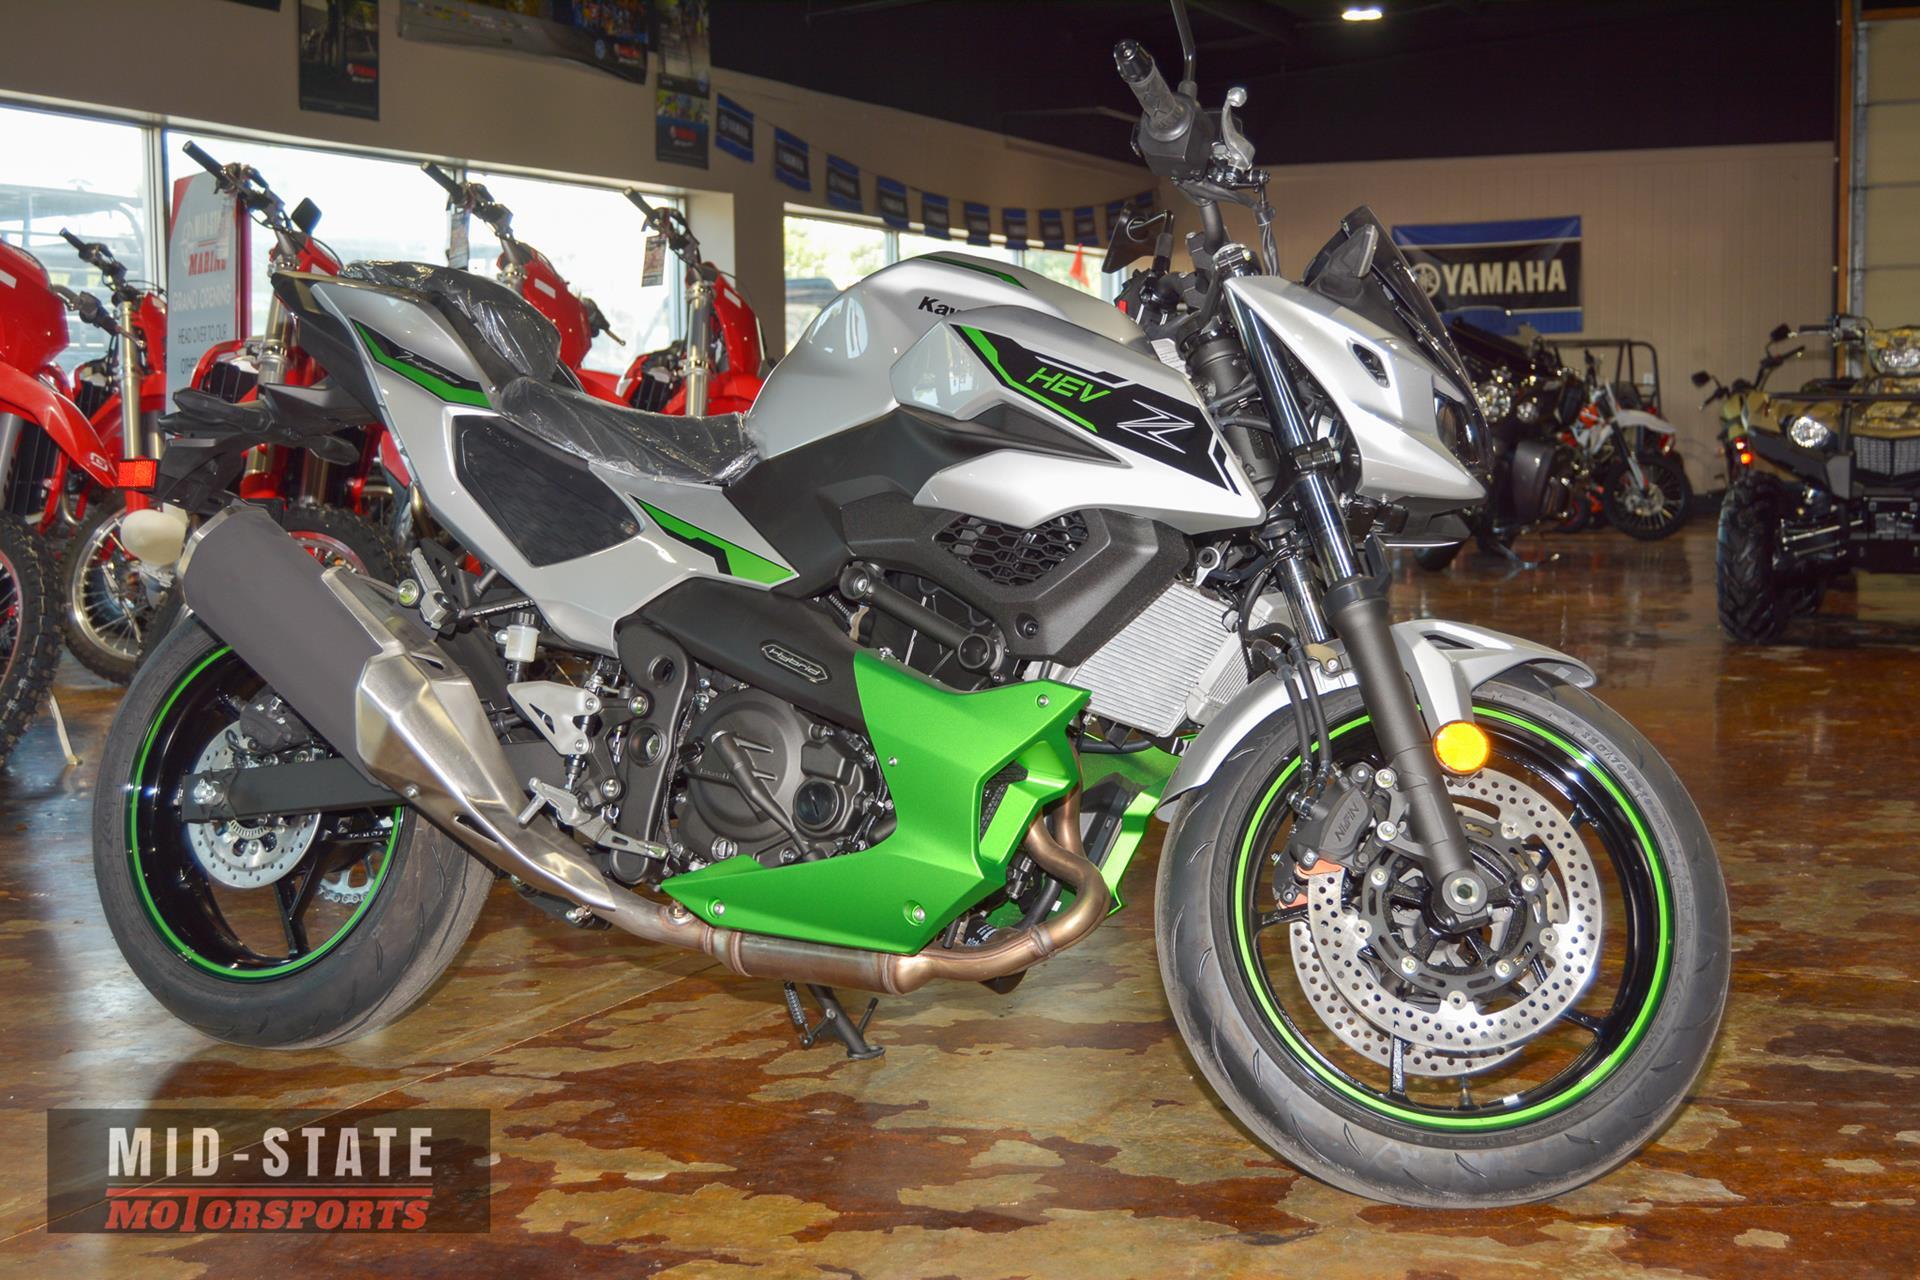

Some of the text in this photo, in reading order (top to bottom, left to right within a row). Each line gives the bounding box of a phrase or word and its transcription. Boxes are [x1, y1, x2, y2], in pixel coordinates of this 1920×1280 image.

[1441, 261, 1567, 296] YAMAHA
[1026, 367, 1111, 402] HEV
[768, 648, 821, 676] Hybrid
